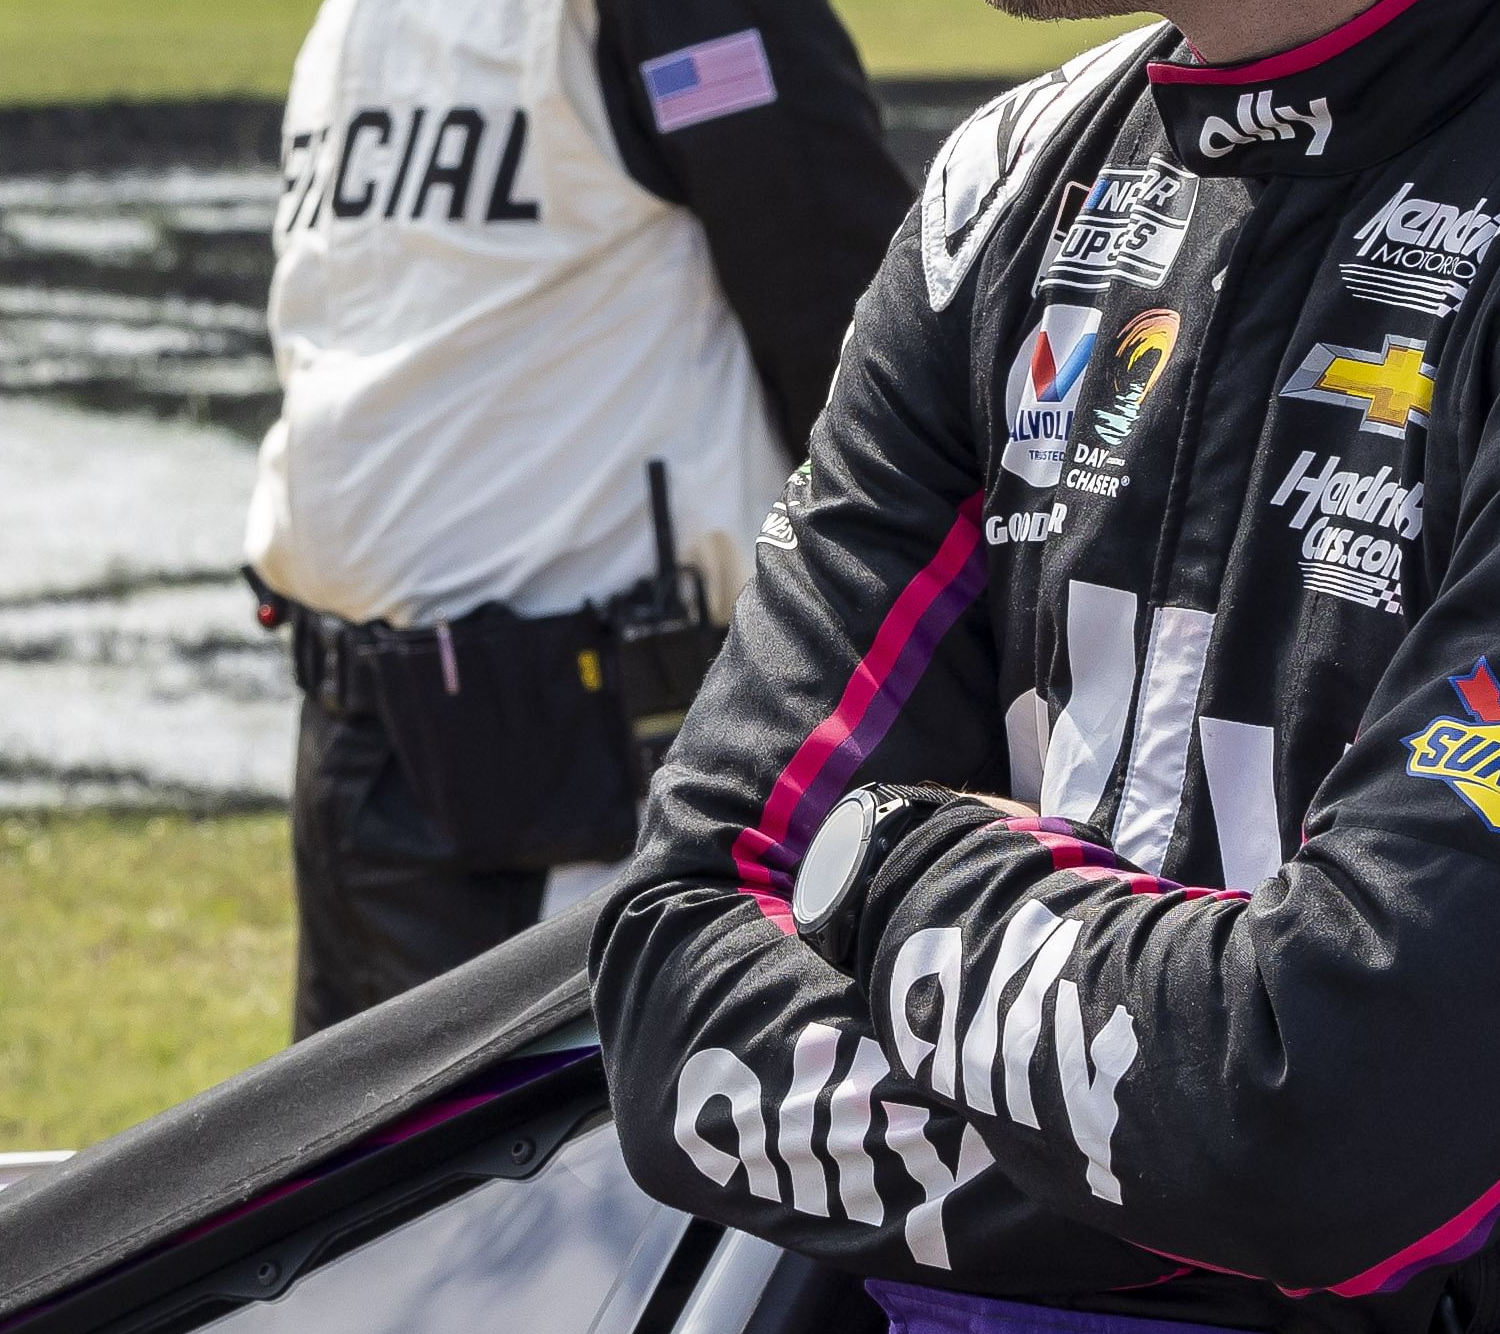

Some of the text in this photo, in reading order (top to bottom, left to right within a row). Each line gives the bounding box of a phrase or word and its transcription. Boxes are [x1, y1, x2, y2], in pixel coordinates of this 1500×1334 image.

[1199, 90, 1333, 157] ally
[1066, 468, 1120, 498] CHASER
[889, 899, 1139, 1206] ally
[674, 1022, 997, 1271] ally
